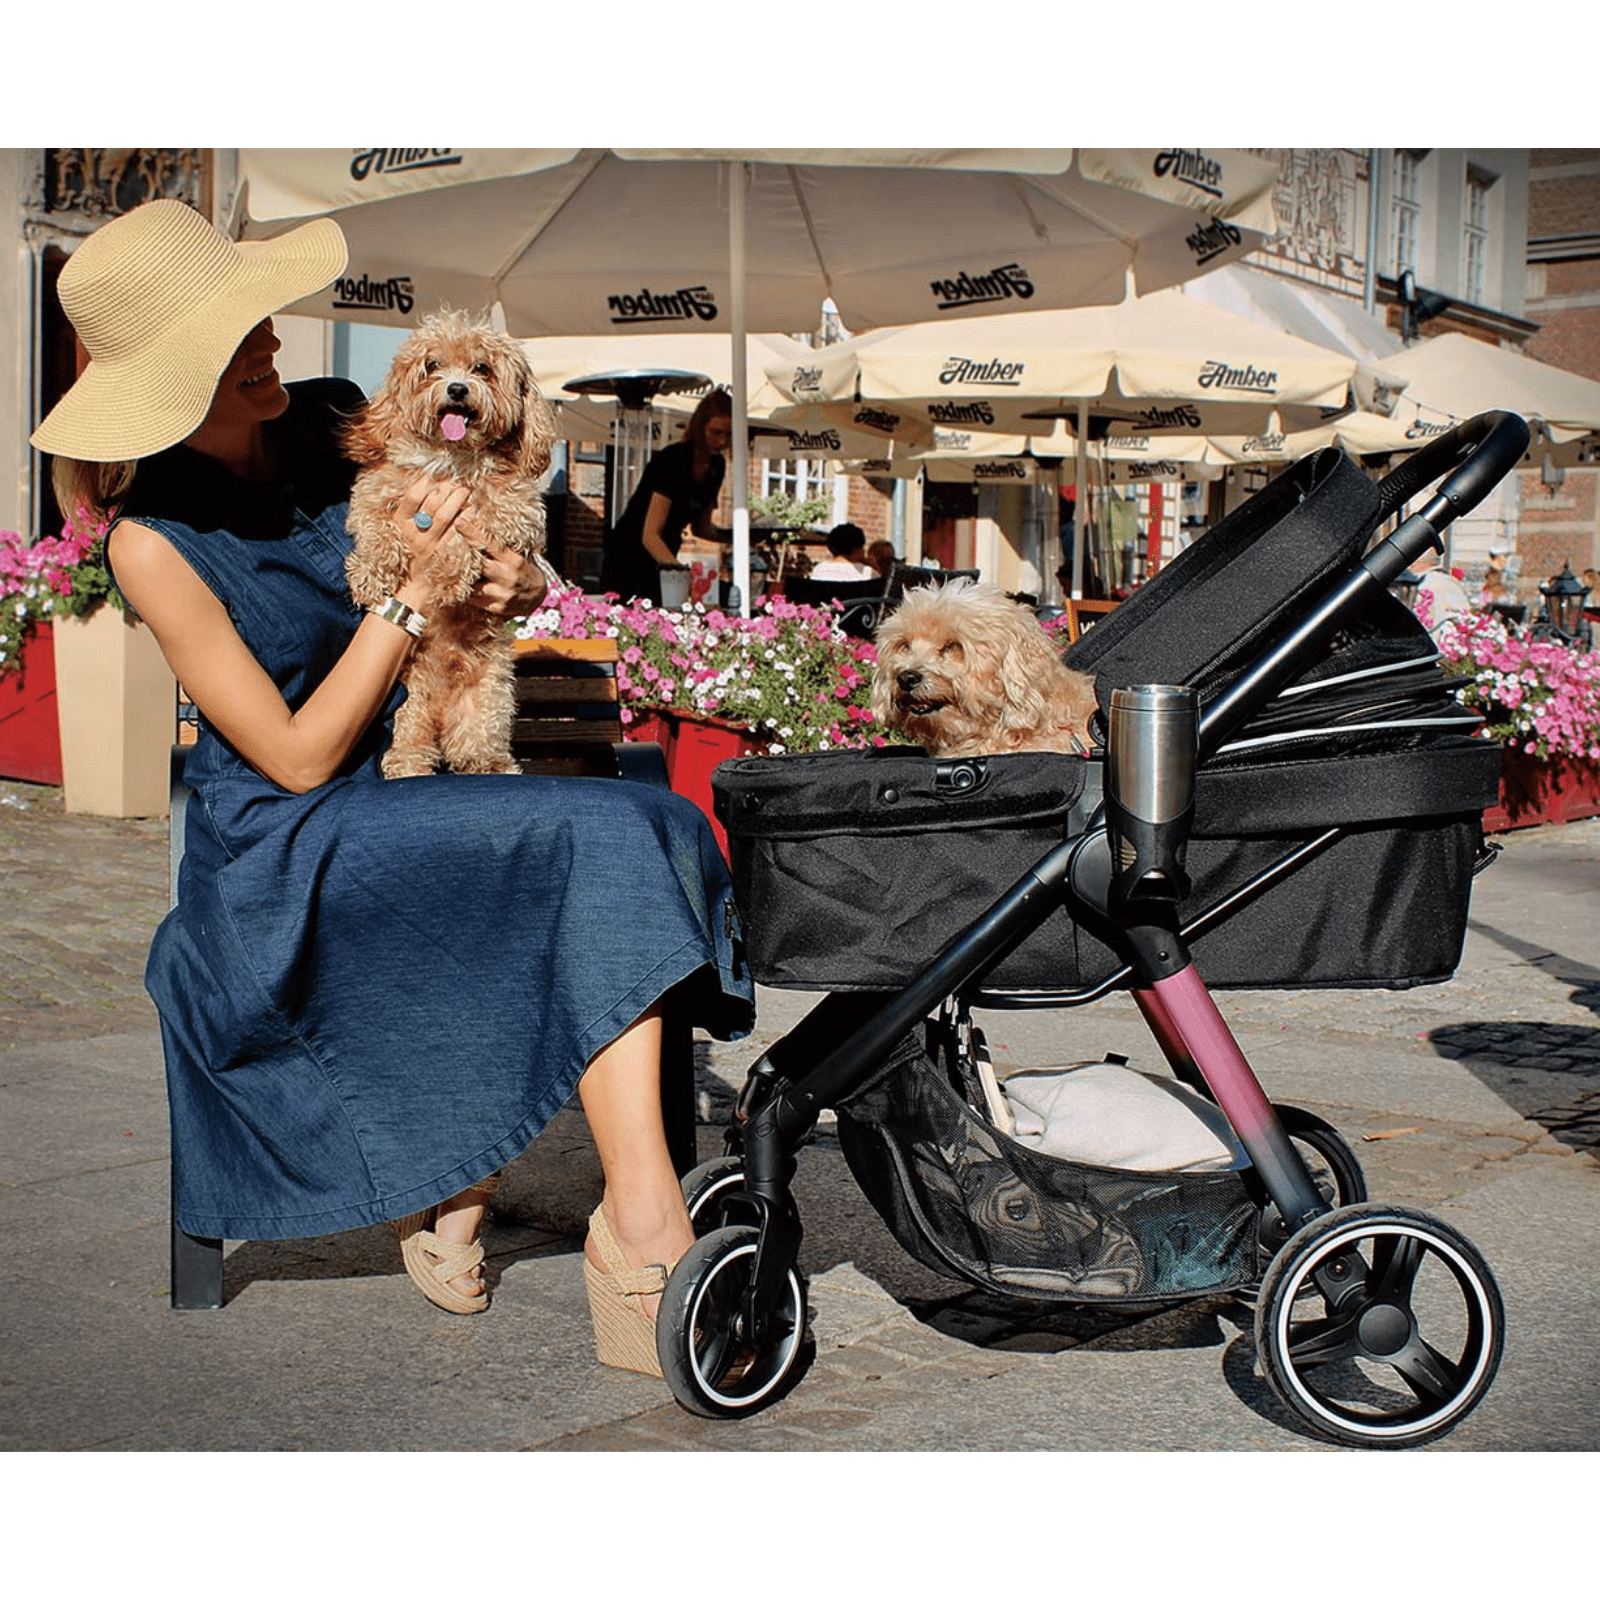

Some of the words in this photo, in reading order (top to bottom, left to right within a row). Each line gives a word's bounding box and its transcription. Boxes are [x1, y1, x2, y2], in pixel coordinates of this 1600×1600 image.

[1154, 148, 1222, 186] Amber
[939, 357, 1024, 385] Amber
[1198, 360, 1277, 389] Amber
[934, 432, 971, 447] mber
